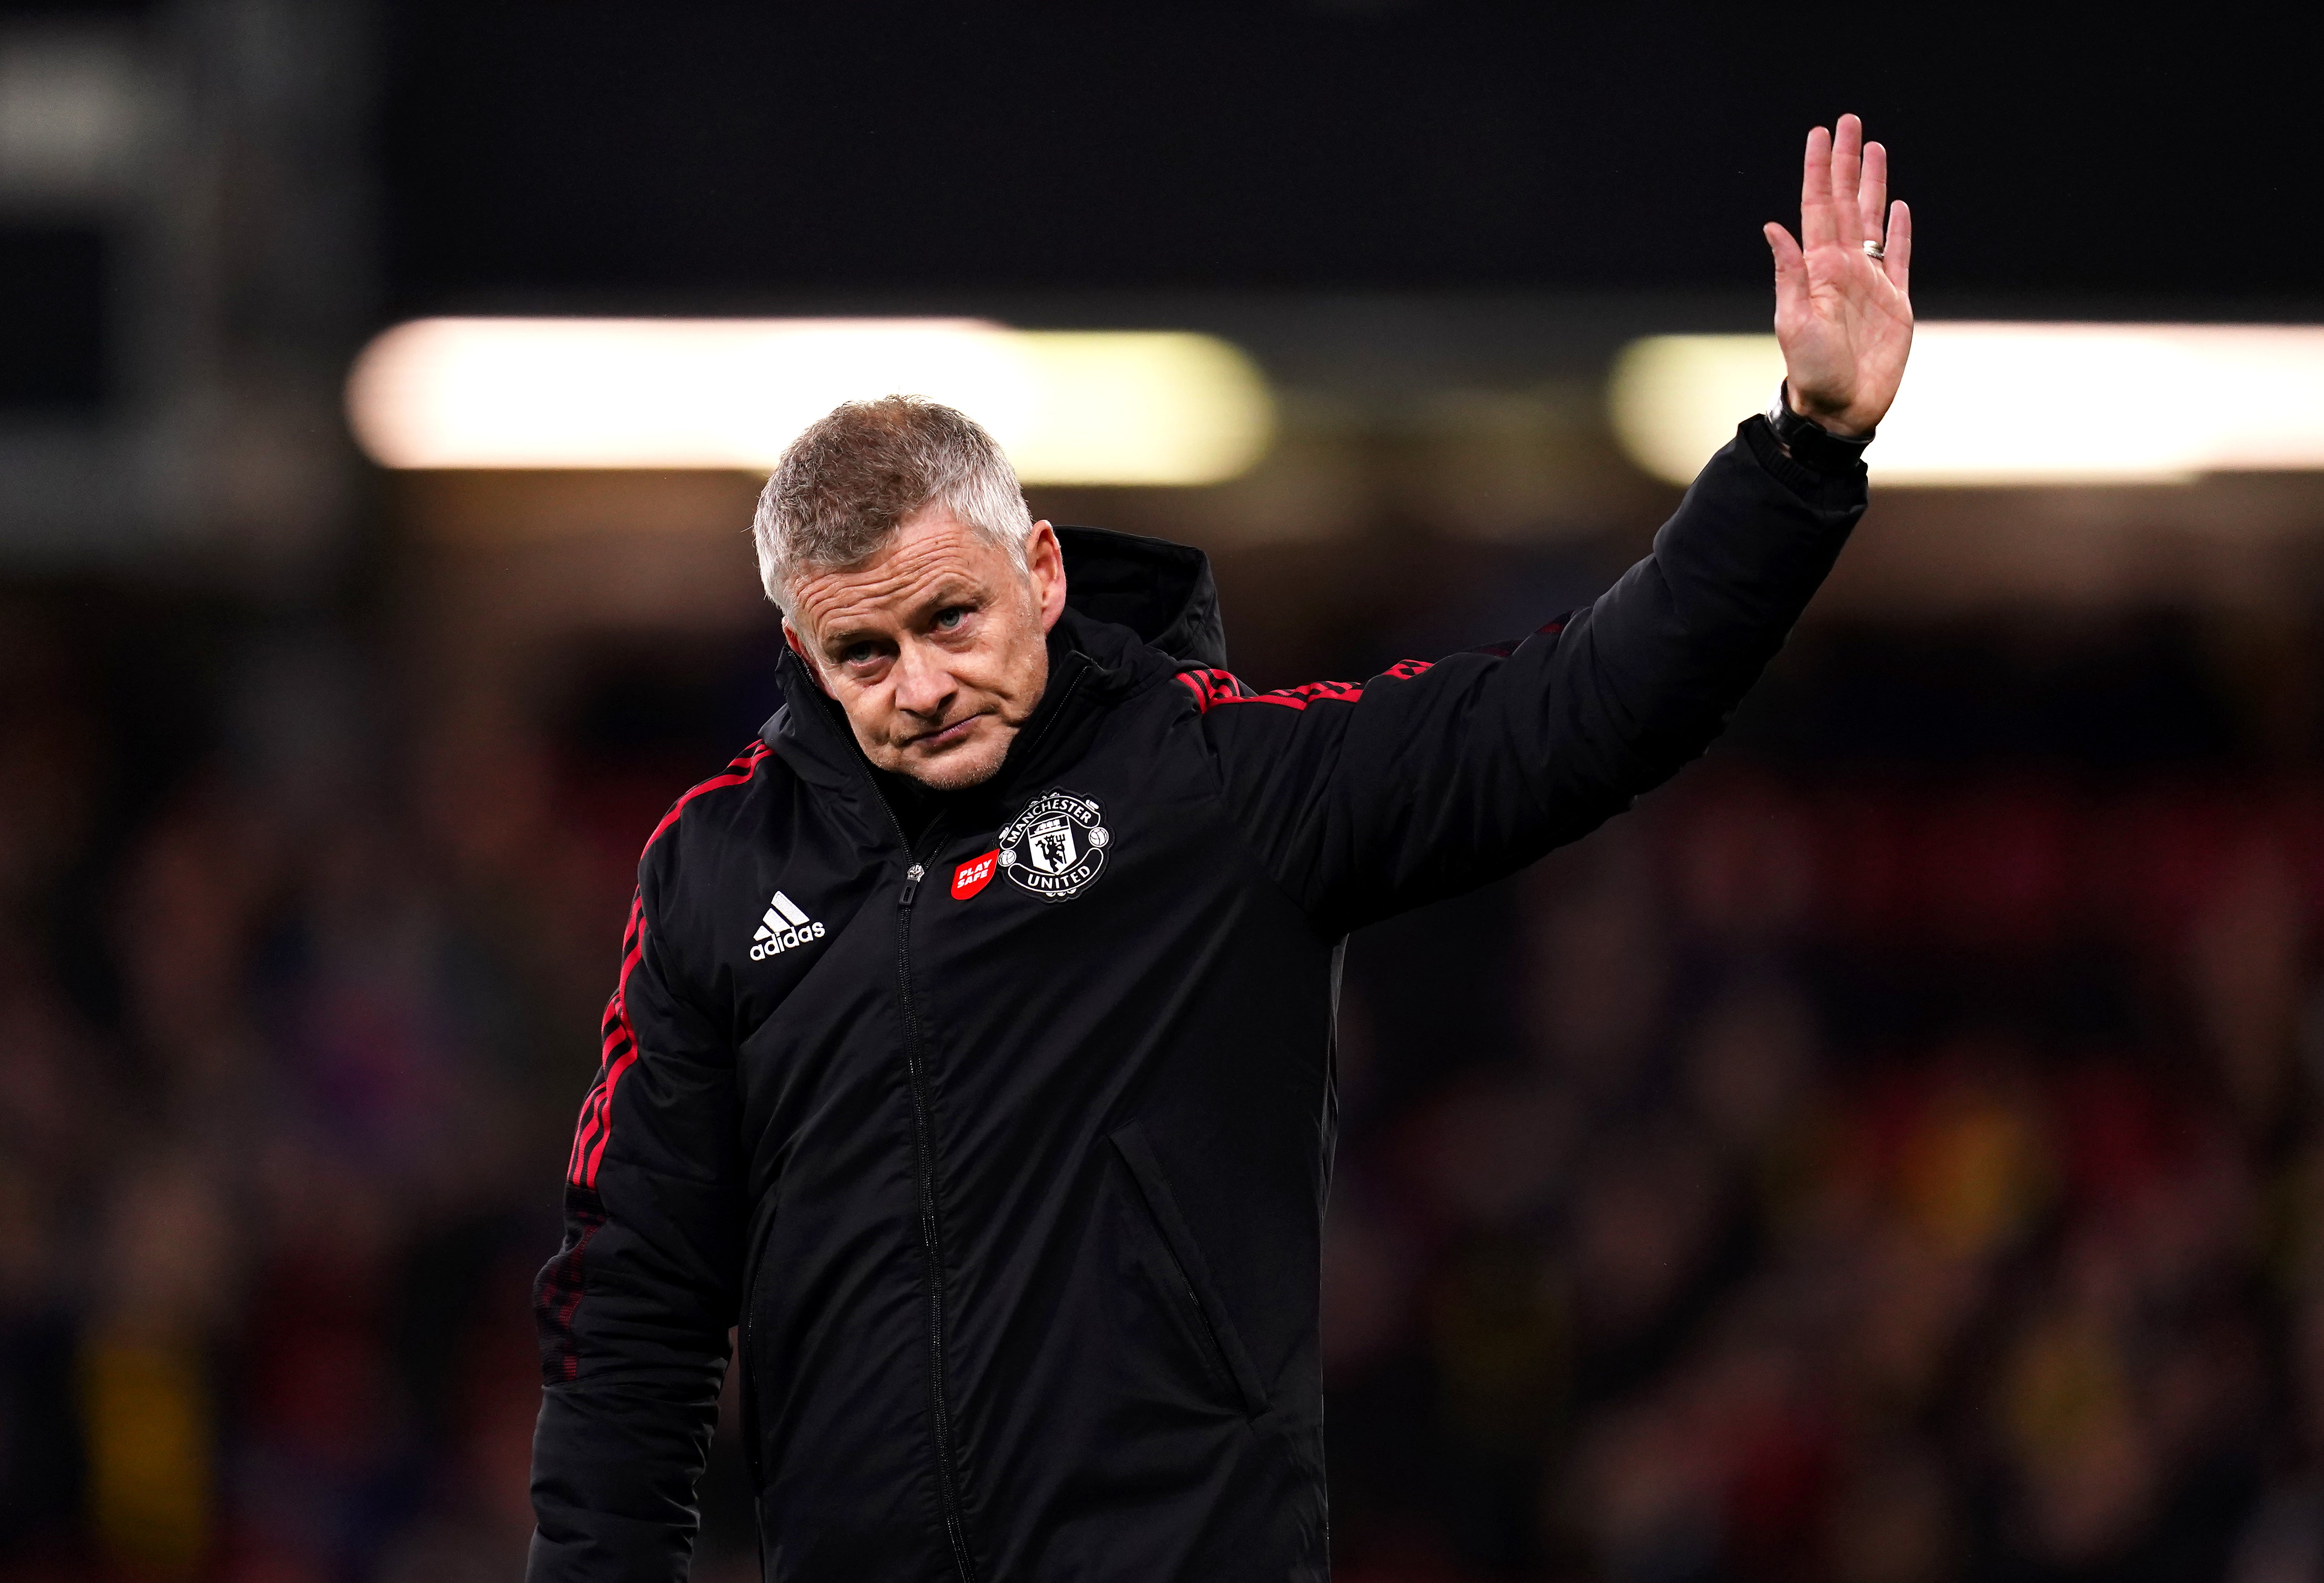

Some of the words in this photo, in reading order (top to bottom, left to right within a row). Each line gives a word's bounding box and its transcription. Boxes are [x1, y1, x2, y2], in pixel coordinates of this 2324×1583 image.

[1008, 799, 1092, 843] MANCHESTER
[957, 868, 988, 889] SAFE
[958, 859, 992, 880] PLAY
[1027, 865, 1090, 889] UNITED
[750, 922, 826, 961] adidas
